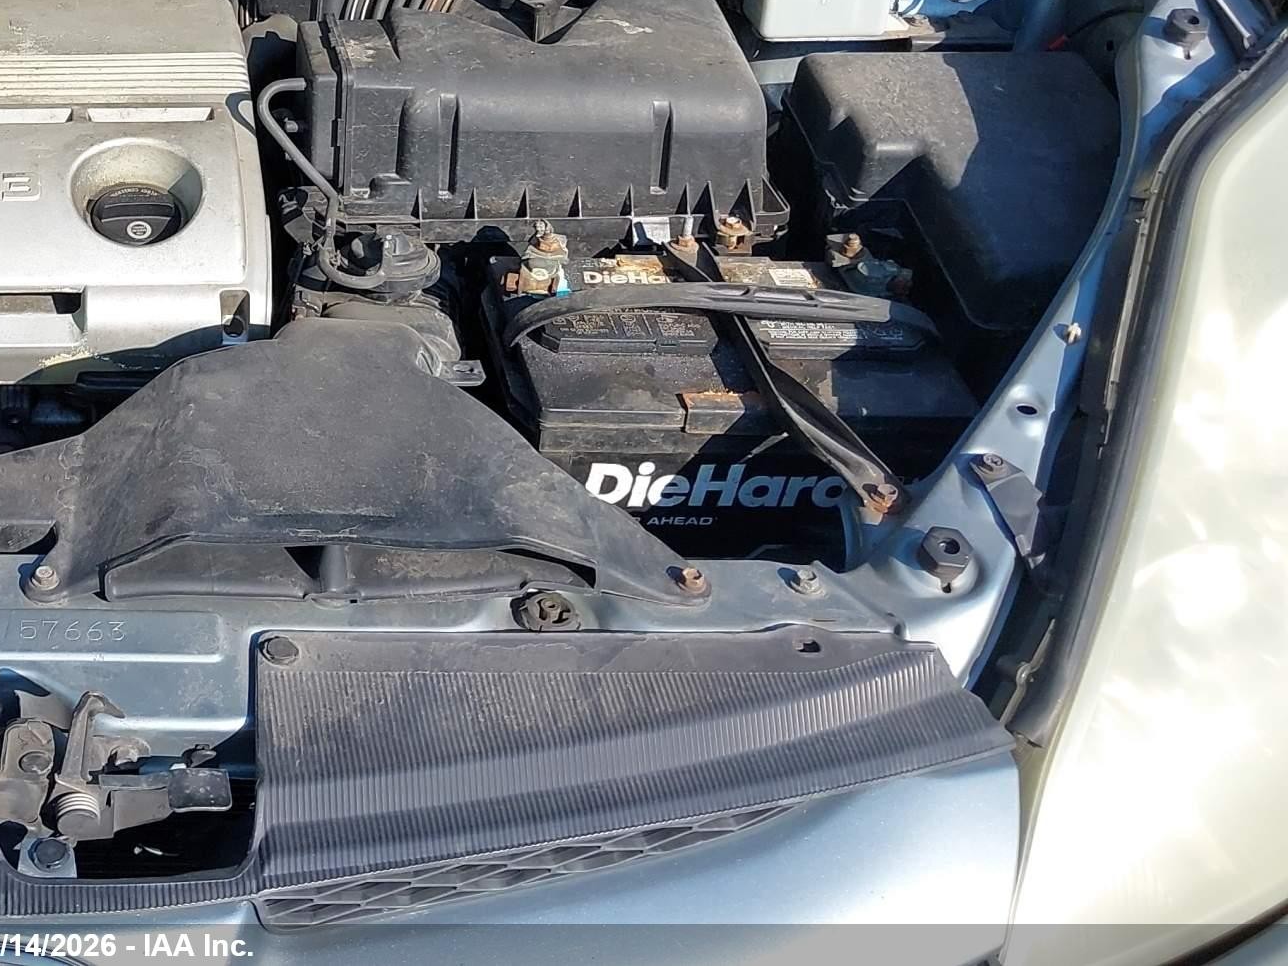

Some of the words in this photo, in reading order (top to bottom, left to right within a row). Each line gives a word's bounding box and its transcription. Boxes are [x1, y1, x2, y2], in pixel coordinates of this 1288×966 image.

[583, 270, 672, 284] DieHa
[647, 516, 713, 526] AHEAD
[20, 619, 126, 641] 57663
